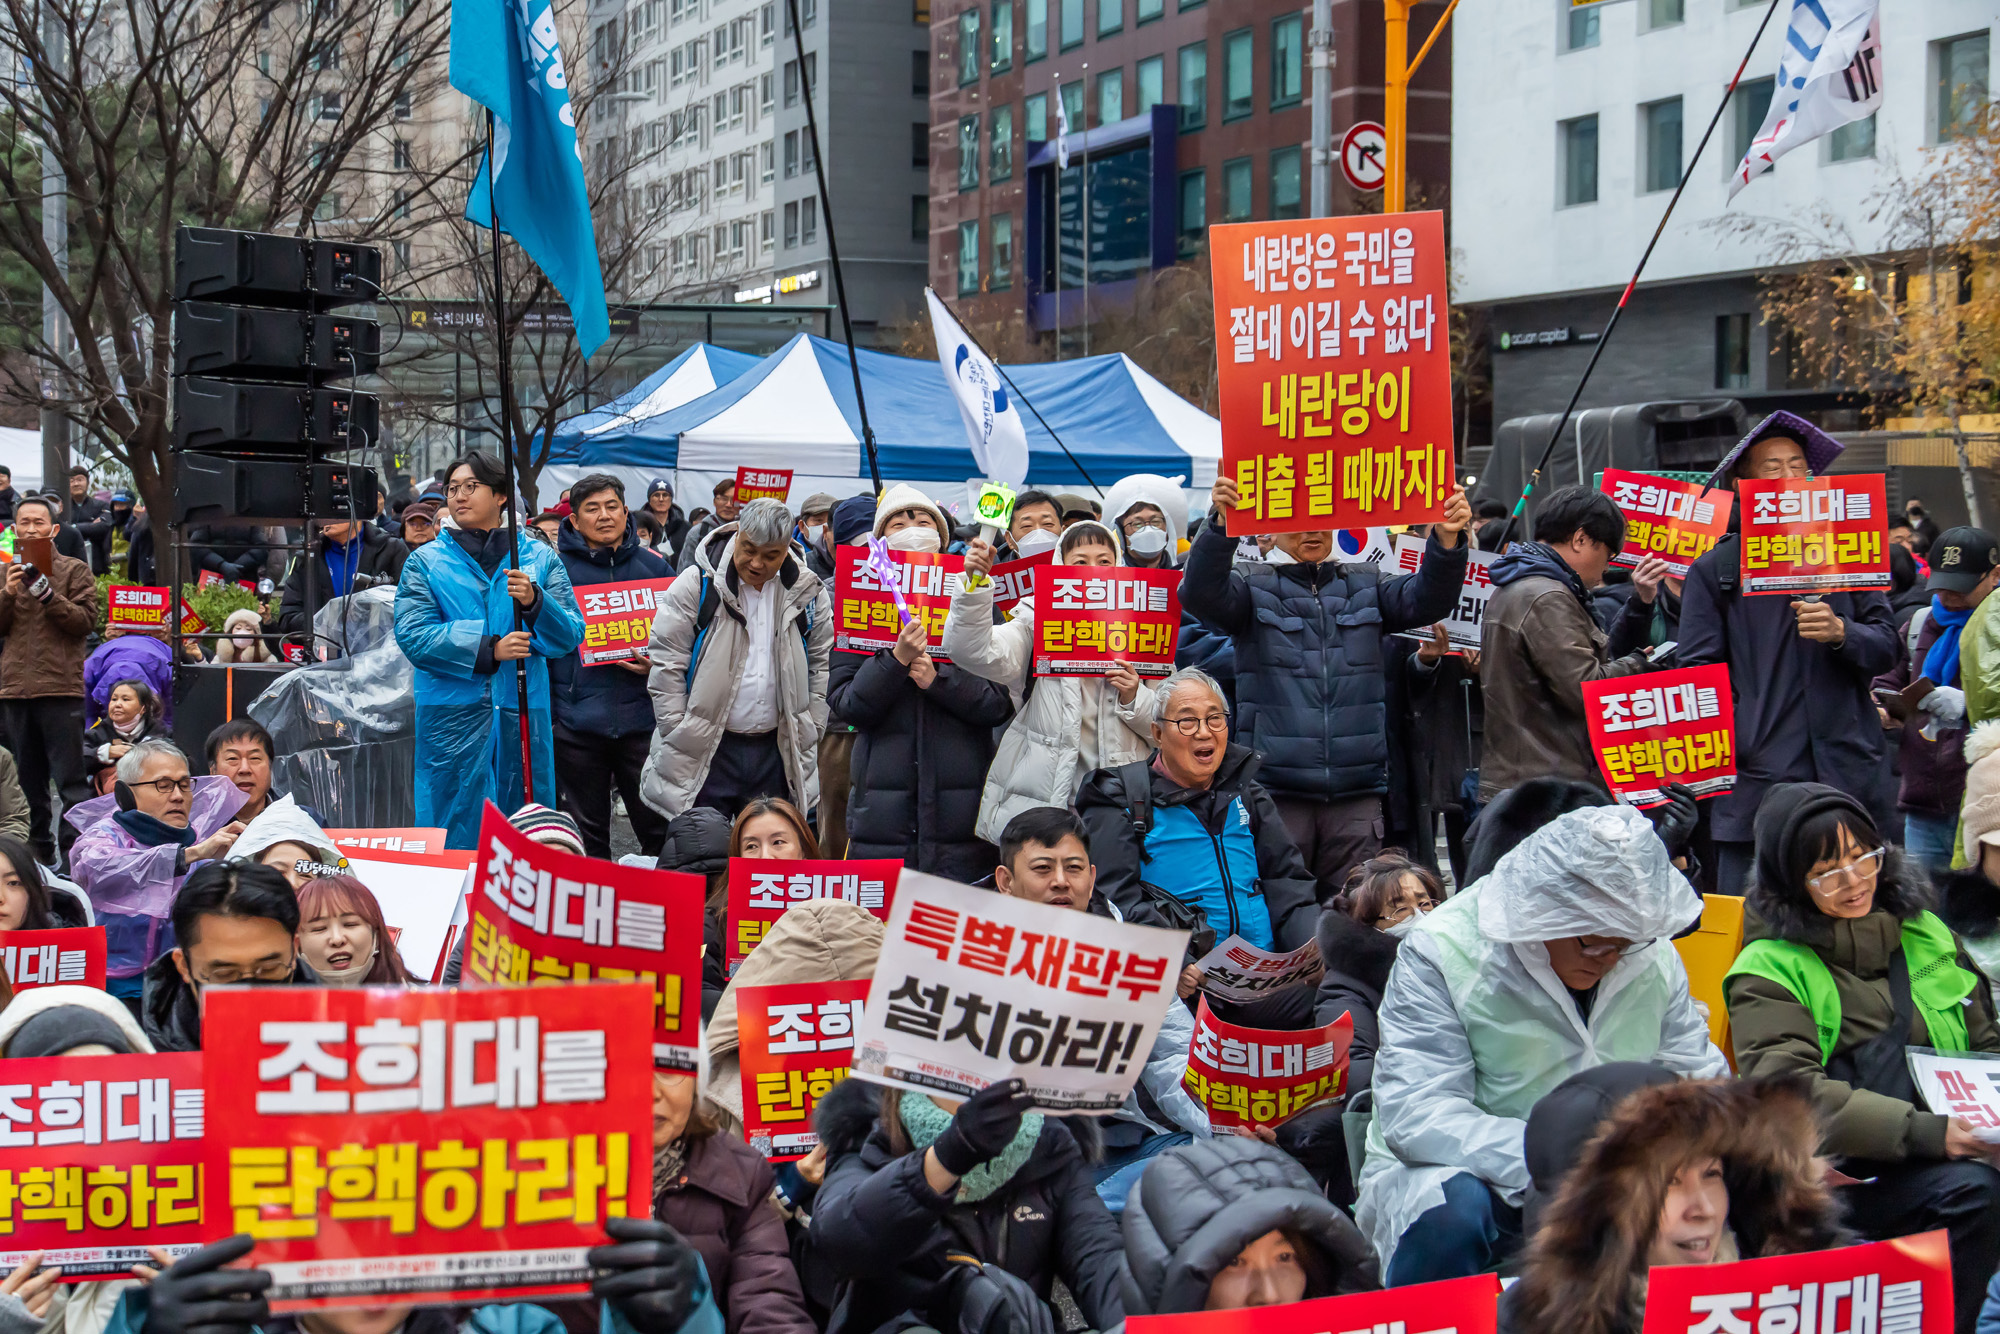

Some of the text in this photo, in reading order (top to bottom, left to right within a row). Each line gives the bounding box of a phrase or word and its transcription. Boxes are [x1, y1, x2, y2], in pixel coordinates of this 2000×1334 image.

[1243, 227, 1415, 293] 내란당은 국민을
[1229, 294, 1435, 363] 절대 이길 수 없다
[1538, 327, 1569, 345] capital
[1262, 366, 1410, 439] 내란당이
[743, 471, 788, 488] 조희대를
[1235, 442, 1446, 520] 퇴출 될 때까지!
[1614, 480, 1715, 525] 조희대를
[1752, 488, 1871, 525] 조희대를
[1625, 519, 1716, 560] 핵하라!
[1746, 530, 1881, 569] 탄핵하라!
[1941, 546, 1962, 569] B
[115, 590, 163, 606] 조희대를
[851, 559, 957, 597] 조희대를
[1051, 578, 1169, 612] 조희대를
[1043, 619, 1173, 655] 탄핵하라!
[1599, 683, 1720, 733] 조희대를
[1601, 729, 1731, 783] 탄핵하라!
[484, 835, 666, 951] 조희대를
[749, 873, 885, 909] 조희대를
[903, 900, 1169, 1002] 특별재판부
[768, 999, 865, 1054] 조희
[884, 975, 1144, 1075] 설치하라!
[1194, 1019, 1334, 1078] 조희대를
[255, 1015, 607, 1114] 조희대를
[0, 1078, 205, 1148] 조희대를
[1185, 1065, 1341, 1122] 탄핵하라!
[229, 1131, 630, 1240] 탄핵하라!
[1687, 1273, 1923, 1334] 조희대를
